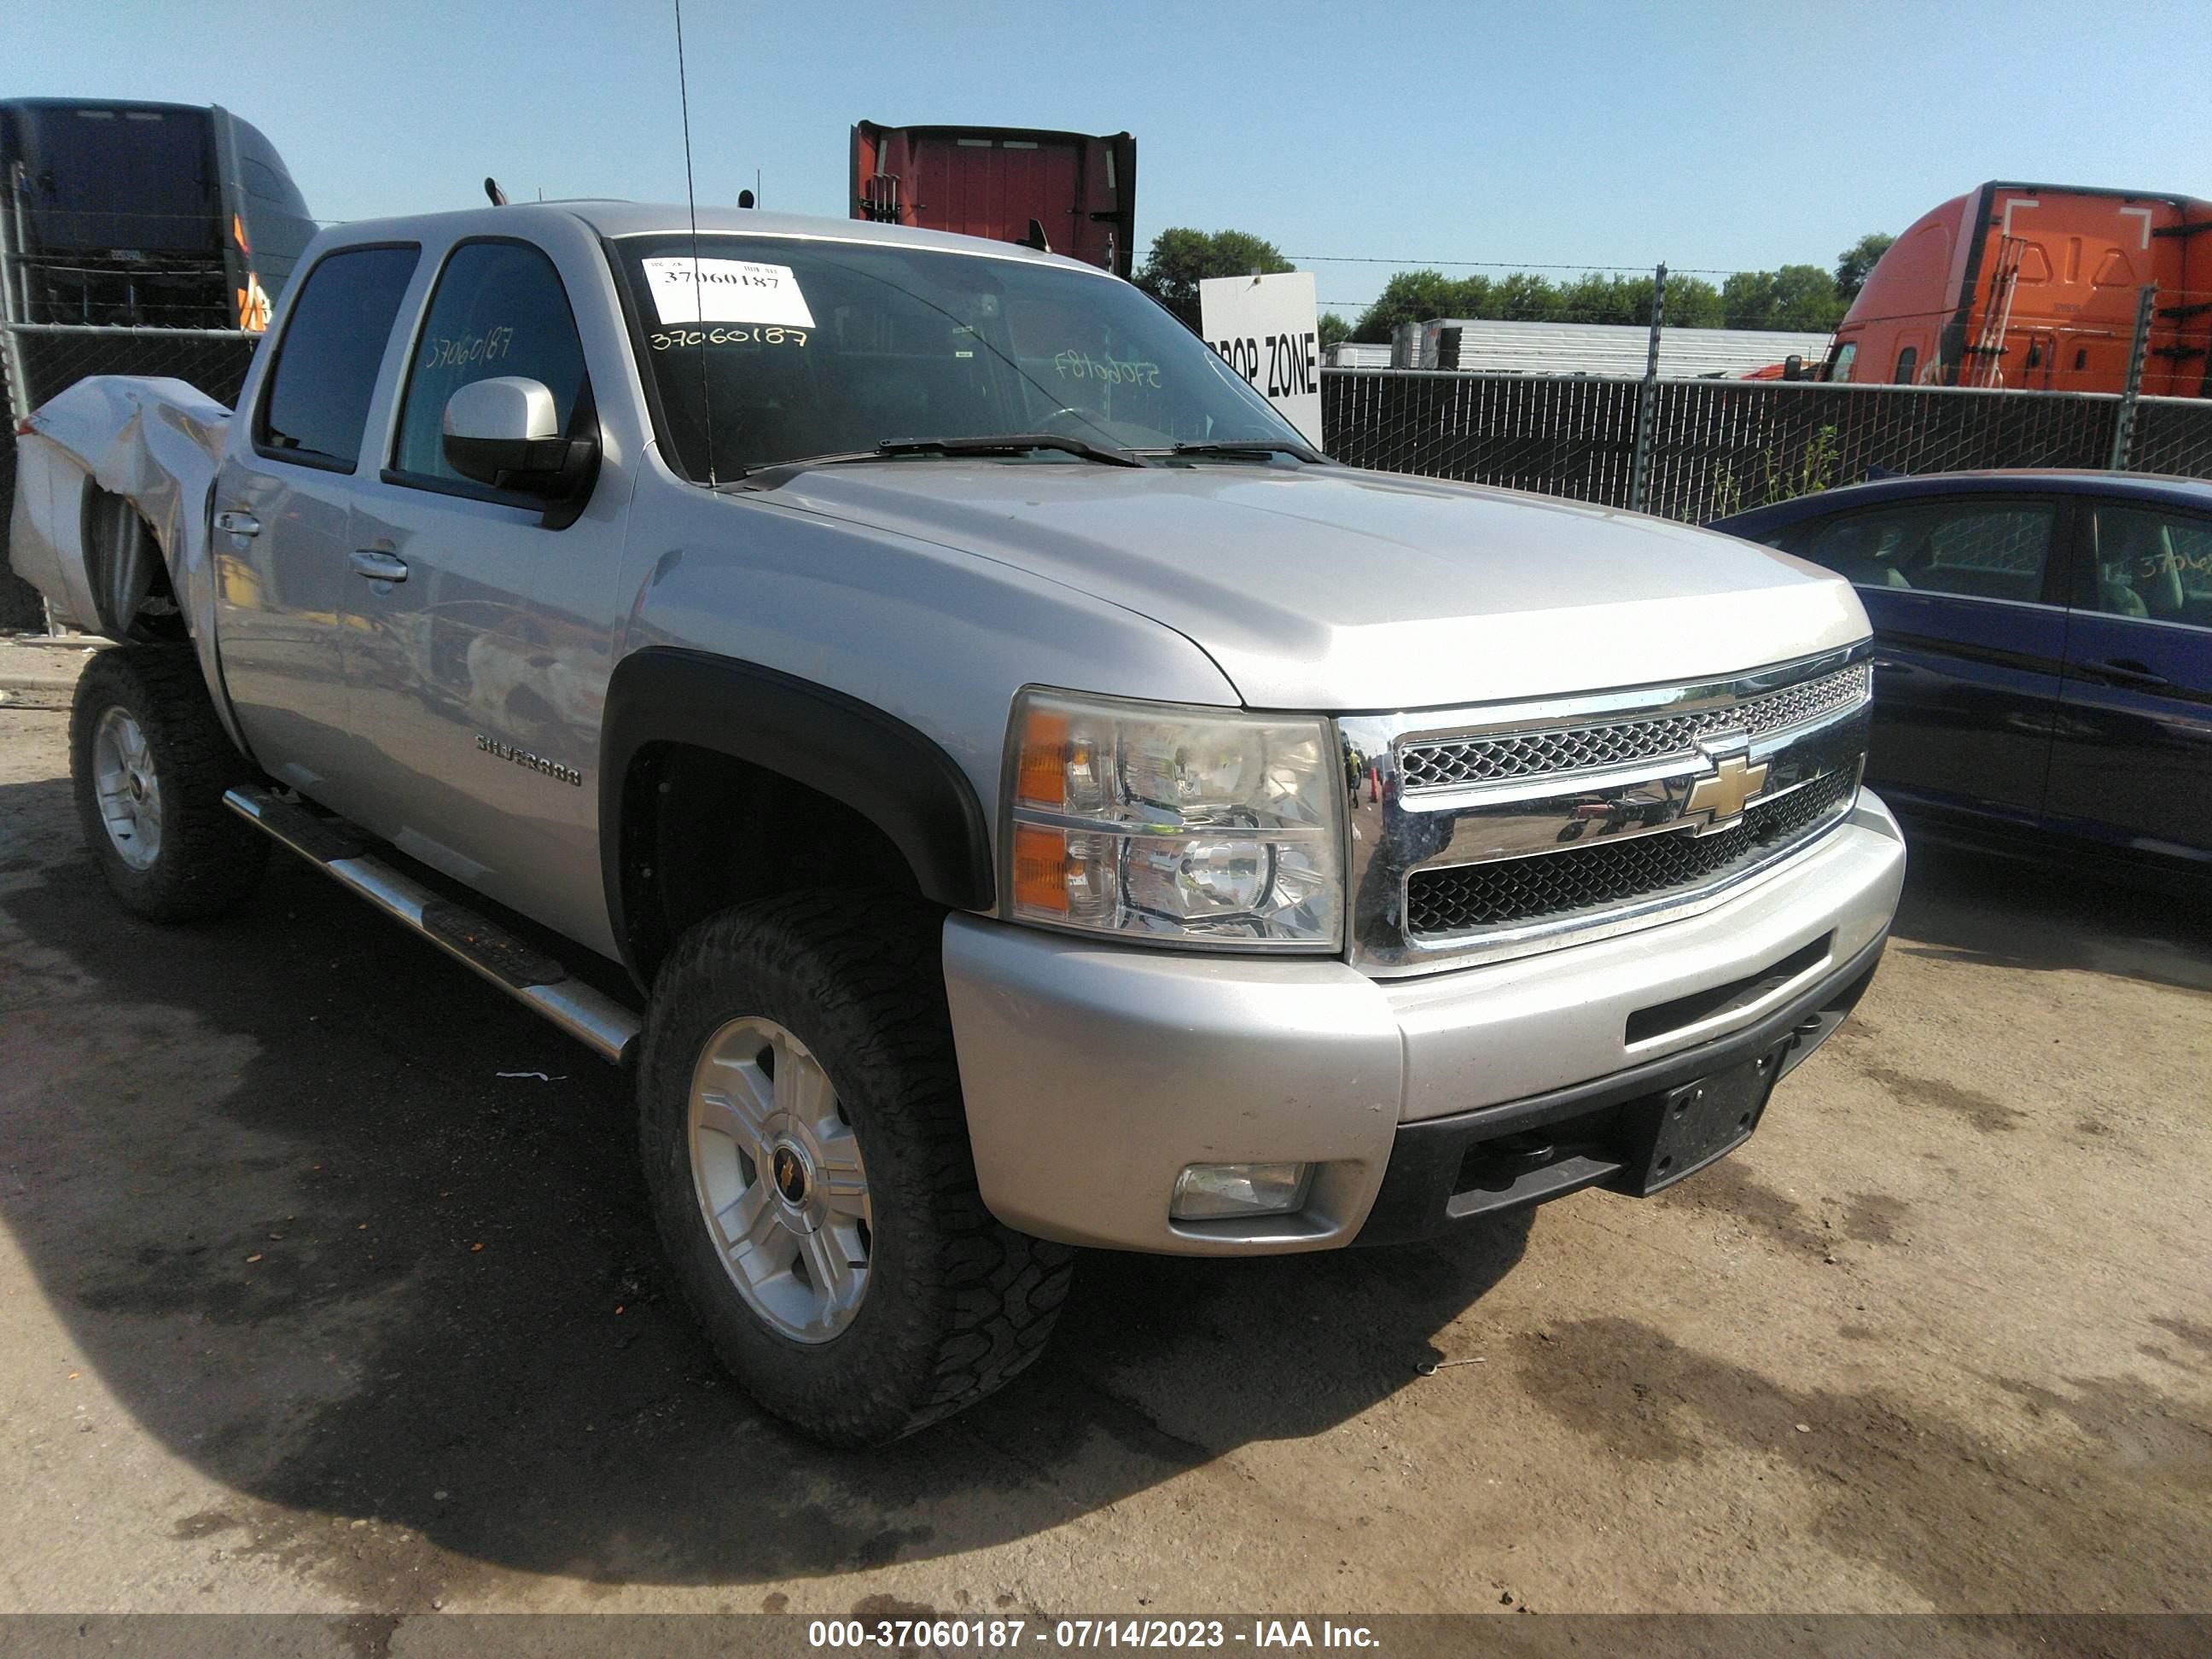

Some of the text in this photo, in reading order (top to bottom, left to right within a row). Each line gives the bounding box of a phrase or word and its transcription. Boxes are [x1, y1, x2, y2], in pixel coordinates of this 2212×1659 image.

[665, 271, 779, 288] 37060187
[426, 326, 514, 369] 37060187
[650, 328, 807, 351] 37060187
[1207, 333, 1318, 398] OP ZONE
[474, 733, 582, 787] SILVERADO
